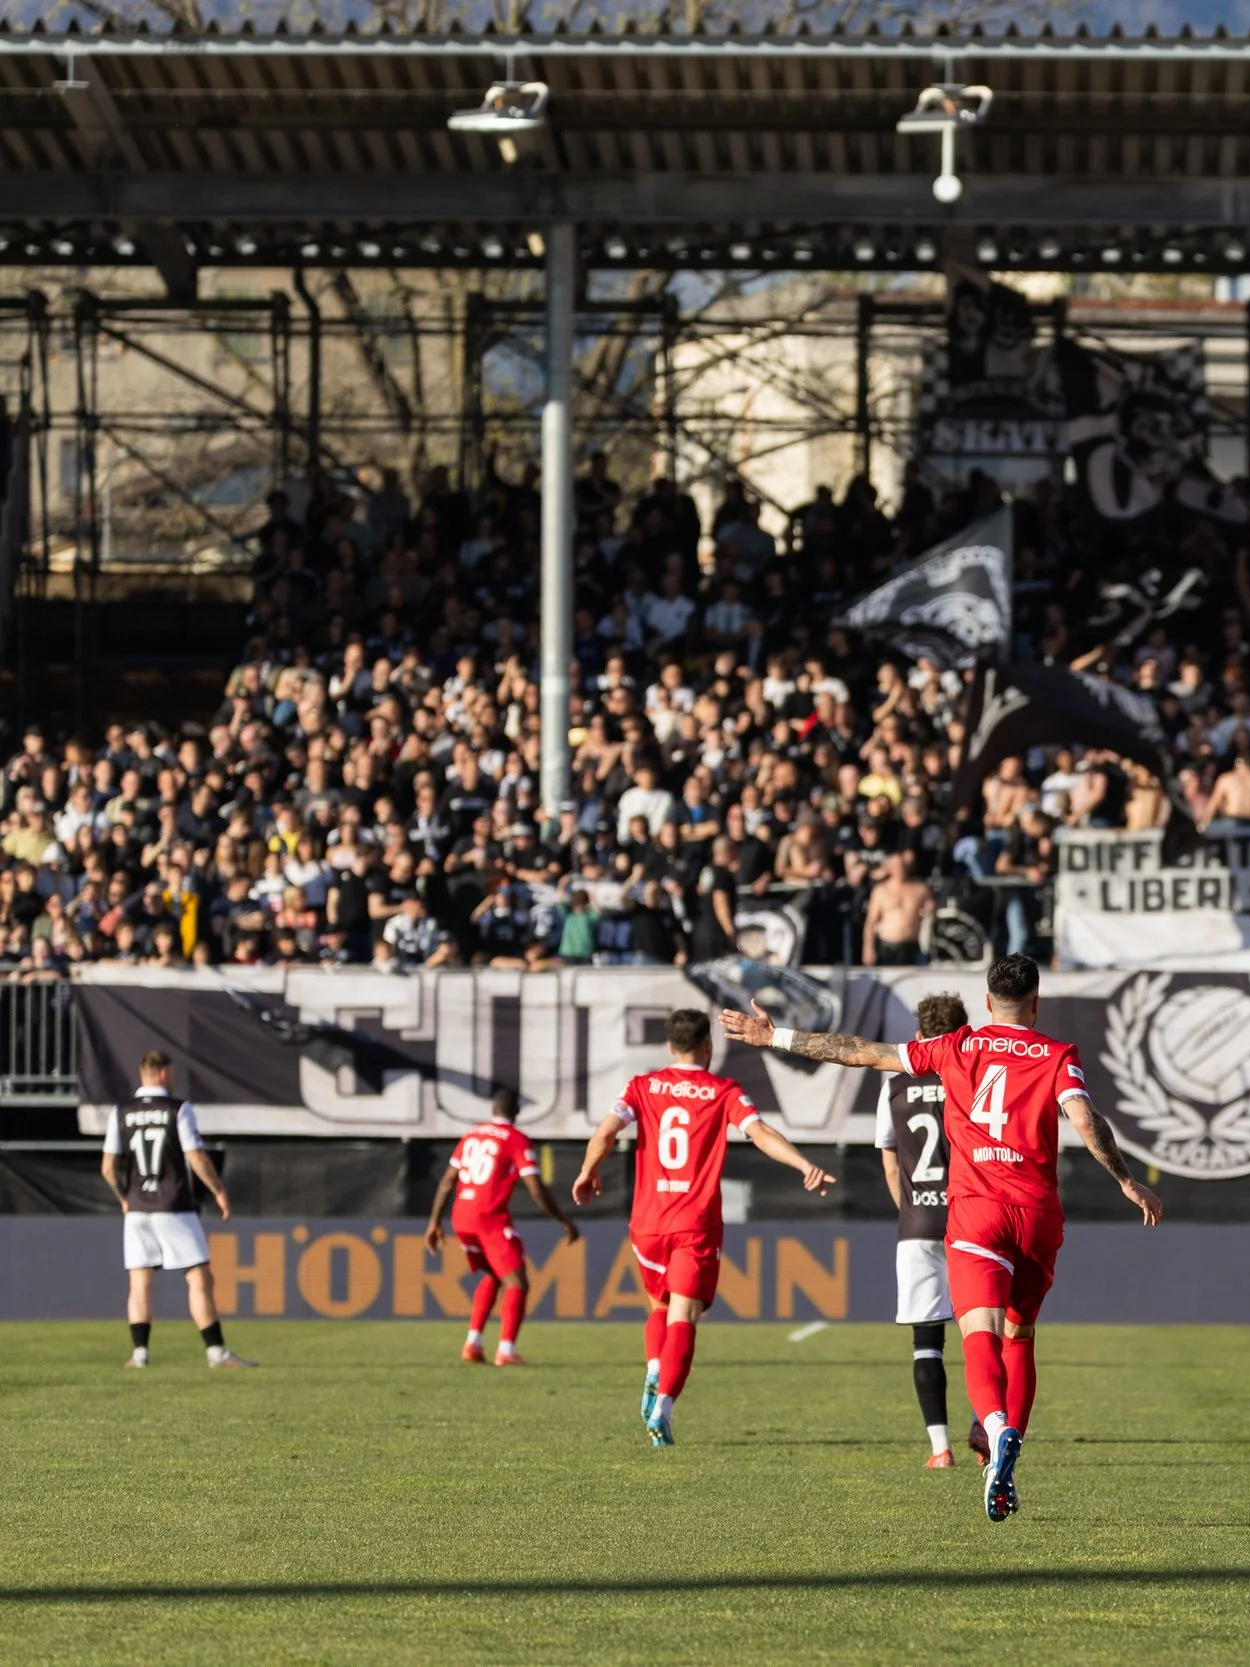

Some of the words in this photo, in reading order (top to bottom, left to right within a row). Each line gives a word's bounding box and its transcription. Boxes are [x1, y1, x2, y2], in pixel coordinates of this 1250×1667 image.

[930, 421, 1071, 453] SKAT
[1101, 876, 1236, 912] LIBERI
[970, 1064, 1007, 1142] 4
[129, 1128, 166, 1176] 17
[459, 1137, 498, 1185] 96
[658, 1106, 690, 1169] 6
[973, 1146, 1024, 1163] MONTOLIO
[912, 1190, 938, 1206] DOS
[208, 1225, 848, 1319] HÖRMANN
